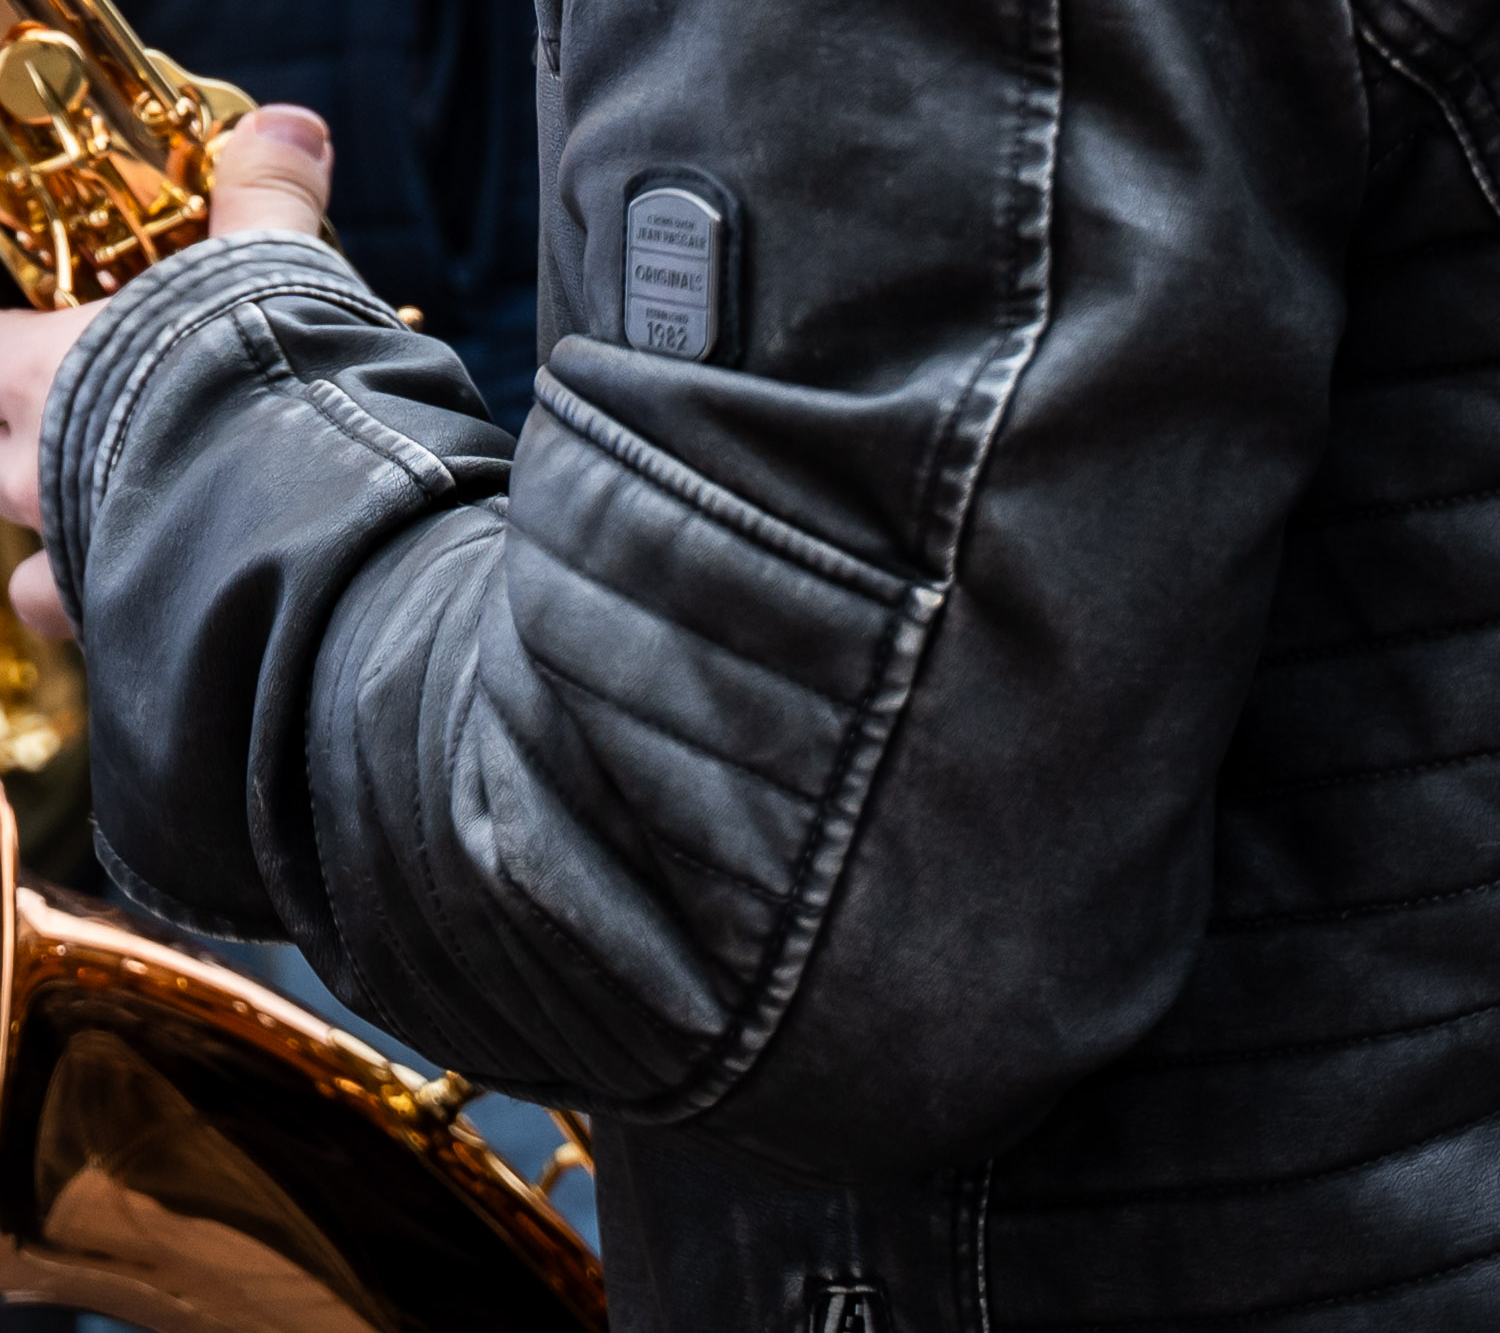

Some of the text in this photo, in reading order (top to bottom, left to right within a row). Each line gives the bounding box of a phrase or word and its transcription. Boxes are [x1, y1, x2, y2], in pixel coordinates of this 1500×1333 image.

[637, 227, 661, 241] JEAN
[635, 264, 703, 292] ORIGINALS
[647, 322, 687, 351] 1982
